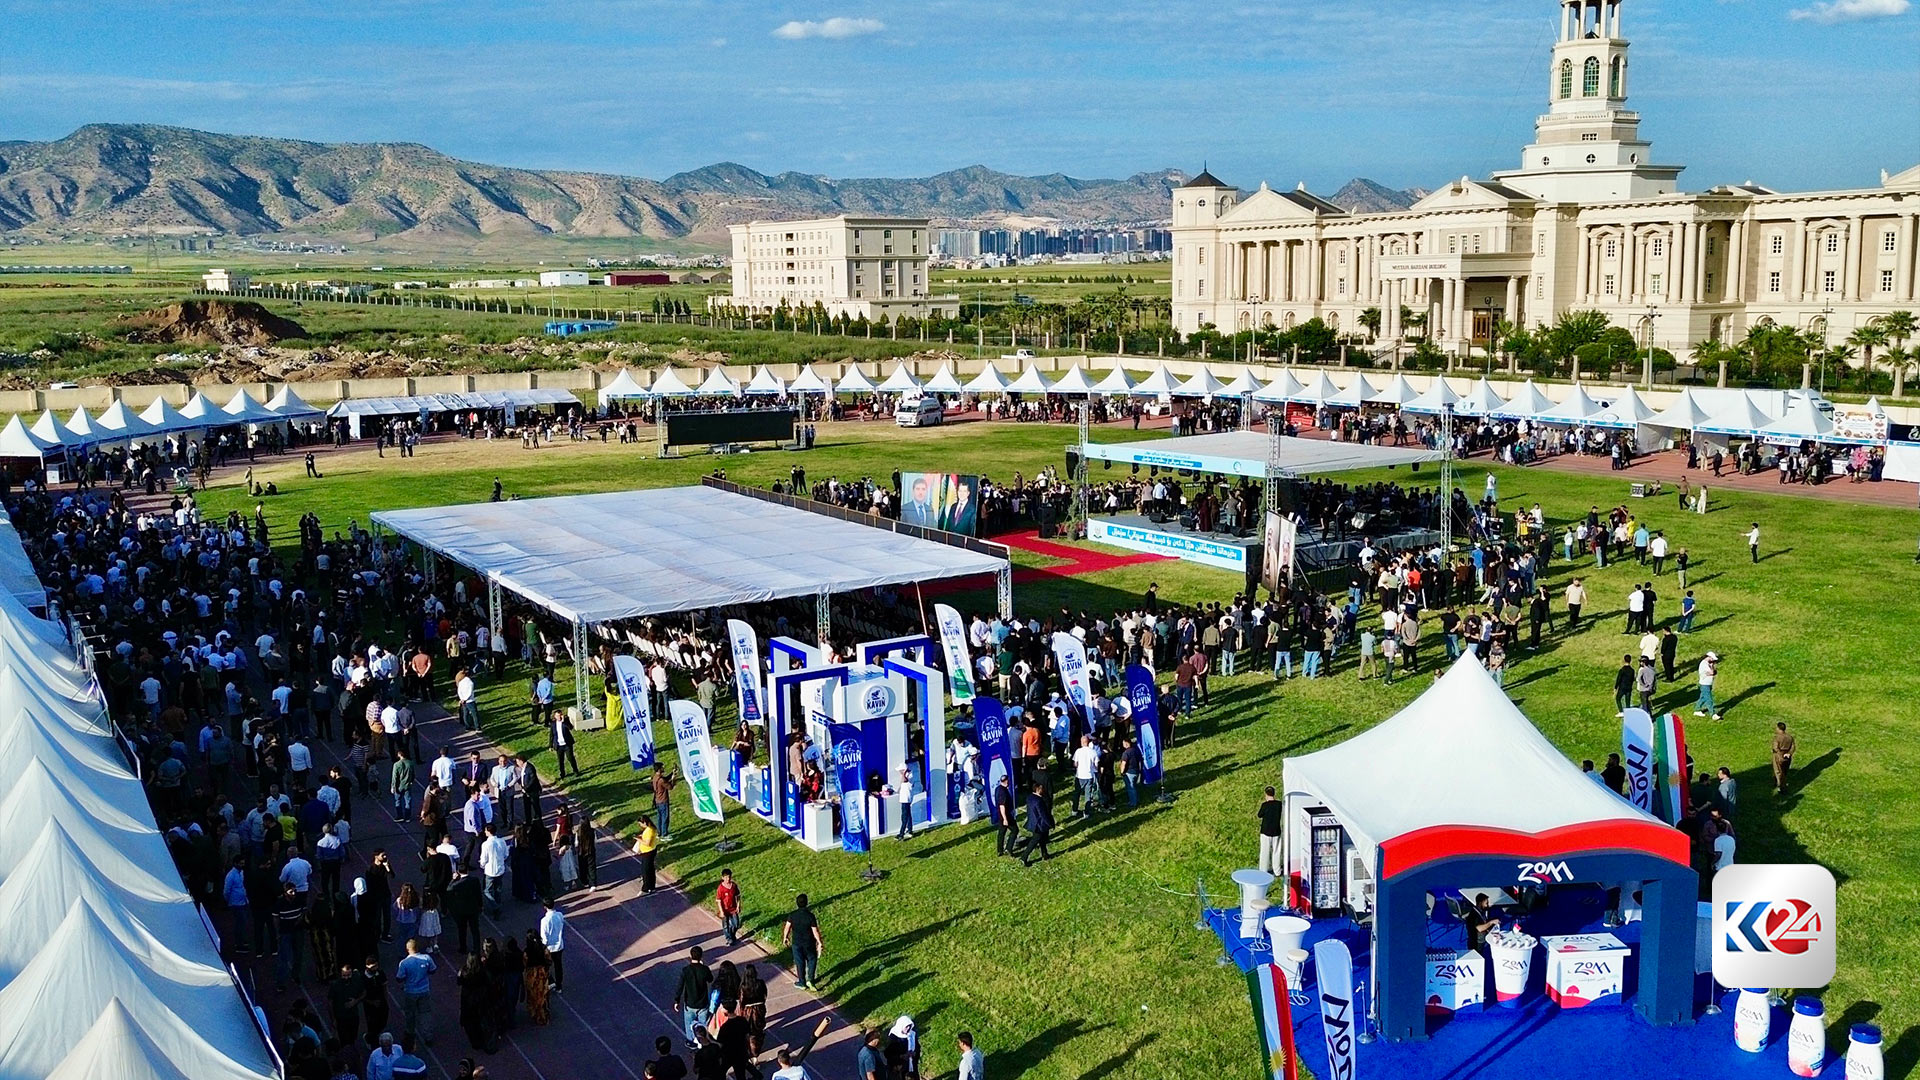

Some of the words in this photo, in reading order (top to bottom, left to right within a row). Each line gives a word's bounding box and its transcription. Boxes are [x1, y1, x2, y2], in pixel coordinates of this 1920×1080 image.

[1061, 661, 1082, 672] KAVIN
[867, 699, 886, 709] KAVIN
[1132, 695, 1152, 708] KAVIN
[678, 727, 703, 740] KAVIN
[982, 727, 1003, 742] KAVIN
[837, 752, 862, 764] KAVIN
[1517, 861, 1575, 884] ZOM
[1434, 964, 1475, 979] ZOM
[1502, 958, 1528, 971] ZOM
[1573, 961, 1611, 975] ZOM
[1739, 1007, 1764, 1021] ZOM
[1791, 1028, 1815, 1043] ZOM
[1848, 1058, 1873, 1075] ZOM
